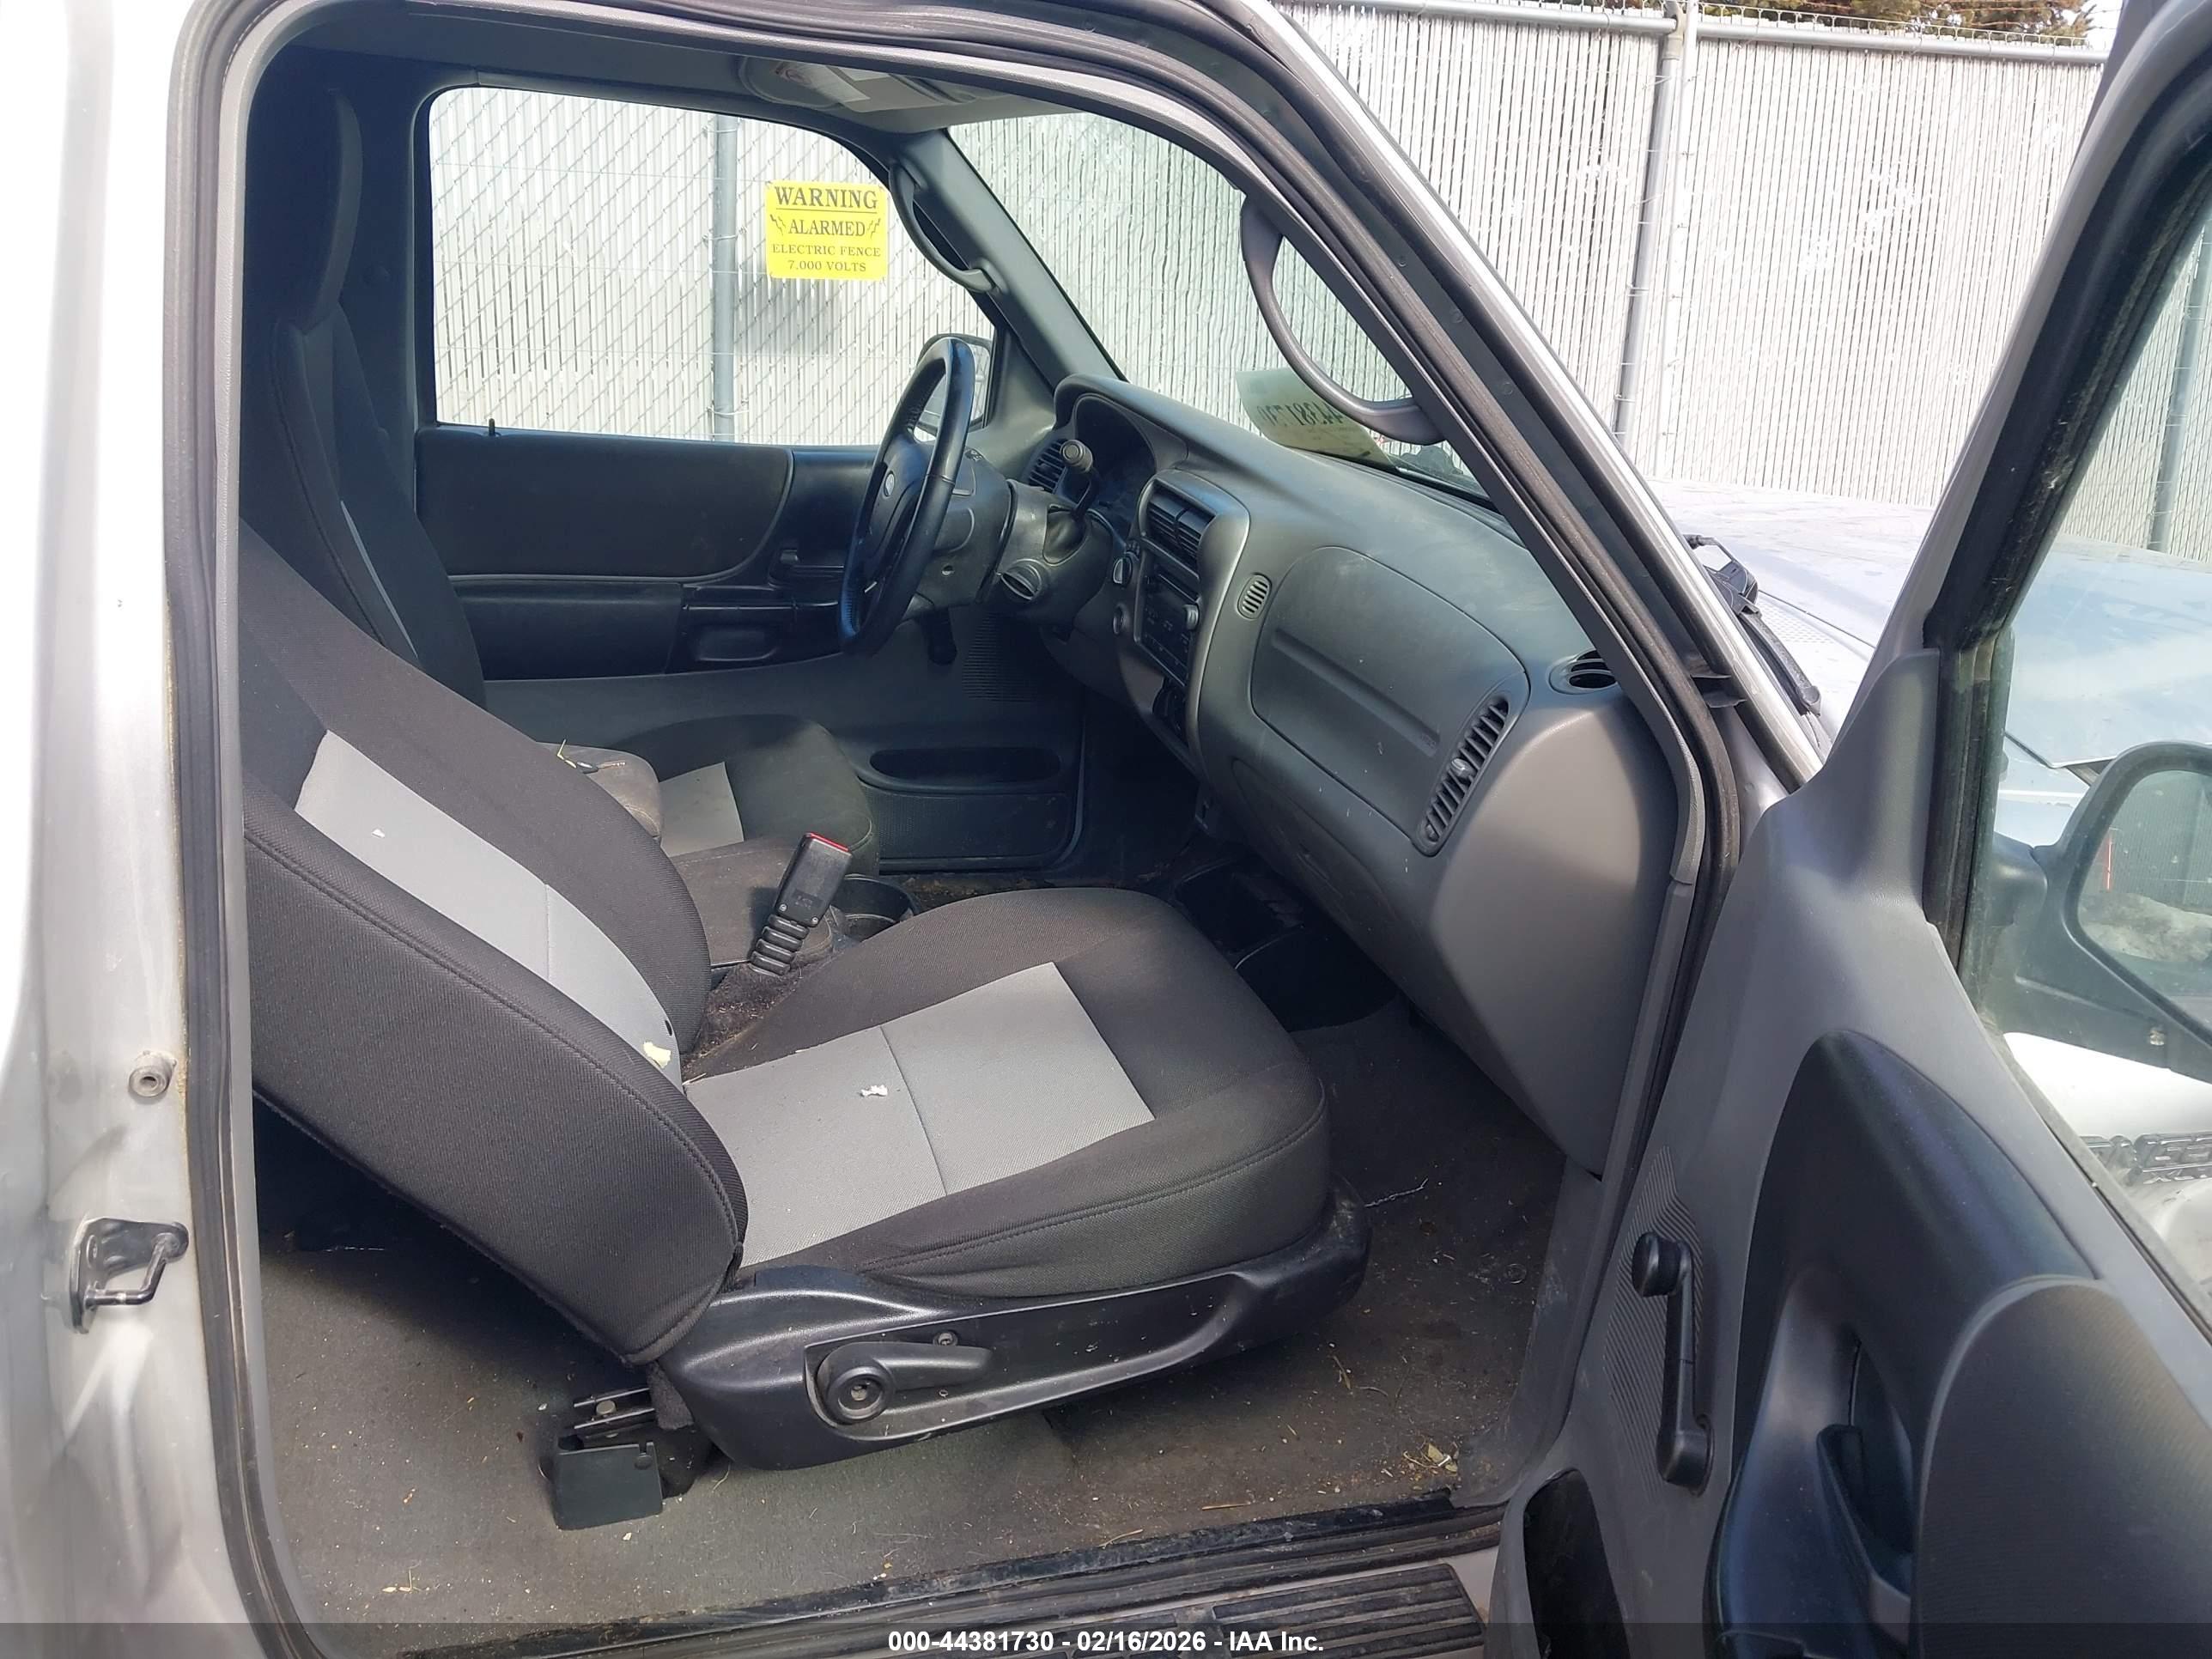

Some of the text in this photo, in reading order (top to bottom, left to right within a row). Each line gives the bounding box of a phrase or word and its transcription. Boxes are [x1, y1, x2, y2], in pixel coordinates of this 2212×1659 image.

[775, 185, 878, 209] WARNING
[788, 219, 866, 236] ALARMED
[773, 244, 881, 257] ELECTRIC FENCE
[826, 261, 866, 272] VOLTS
